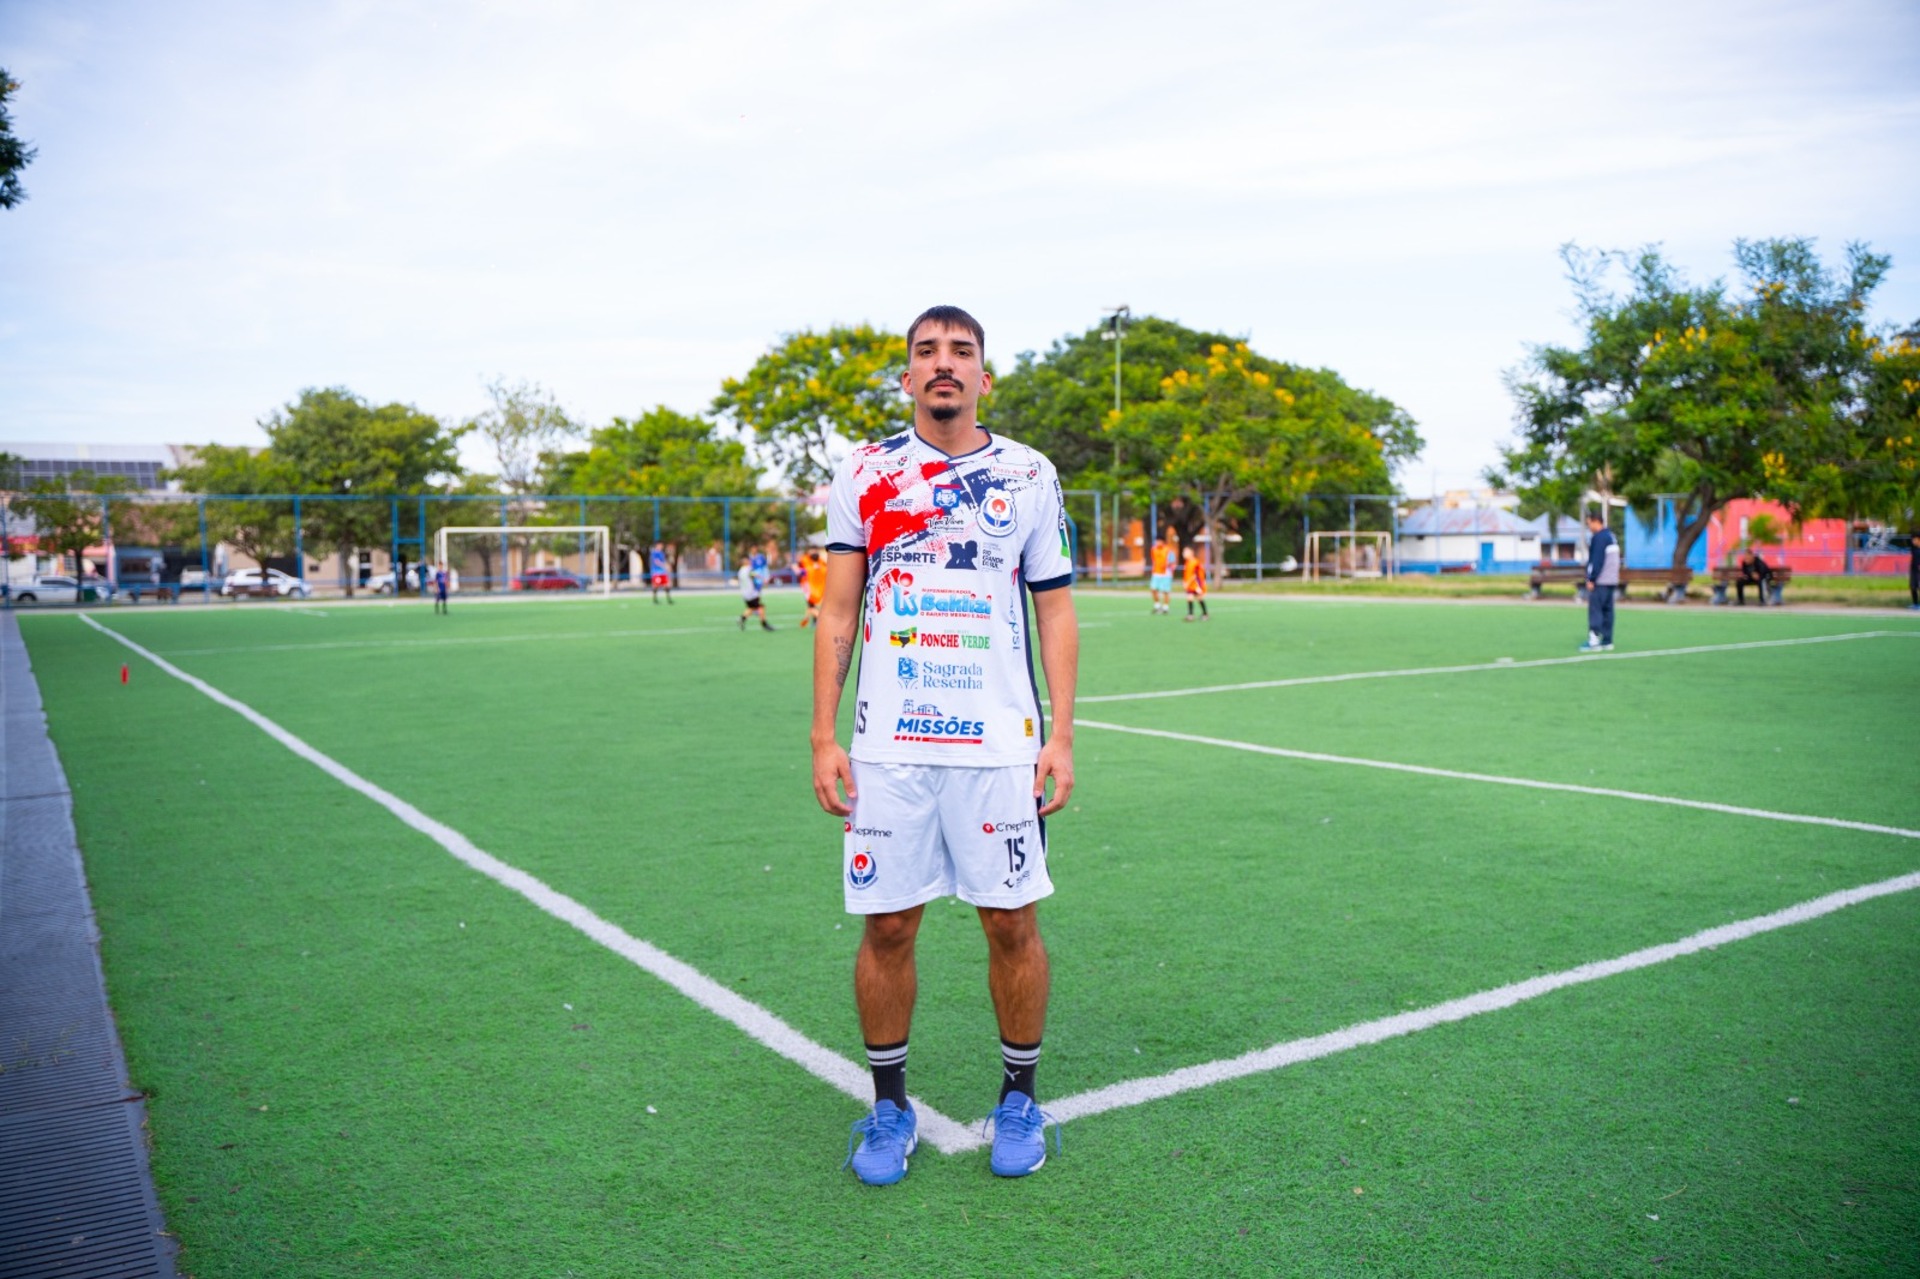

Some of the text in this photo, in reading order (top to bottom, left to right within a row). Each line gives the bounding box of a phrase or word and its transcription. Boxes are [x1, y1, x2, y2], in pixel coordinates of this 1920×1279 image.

[920, 633, 990, 649] PONCHE VERDE
[922, 660, 983, 678] Sagrada
[923, 675, 983, 690] Resenha
[896, 716, 985, 736] MISSÕES
[1004, 836, 1026, 873] 15
